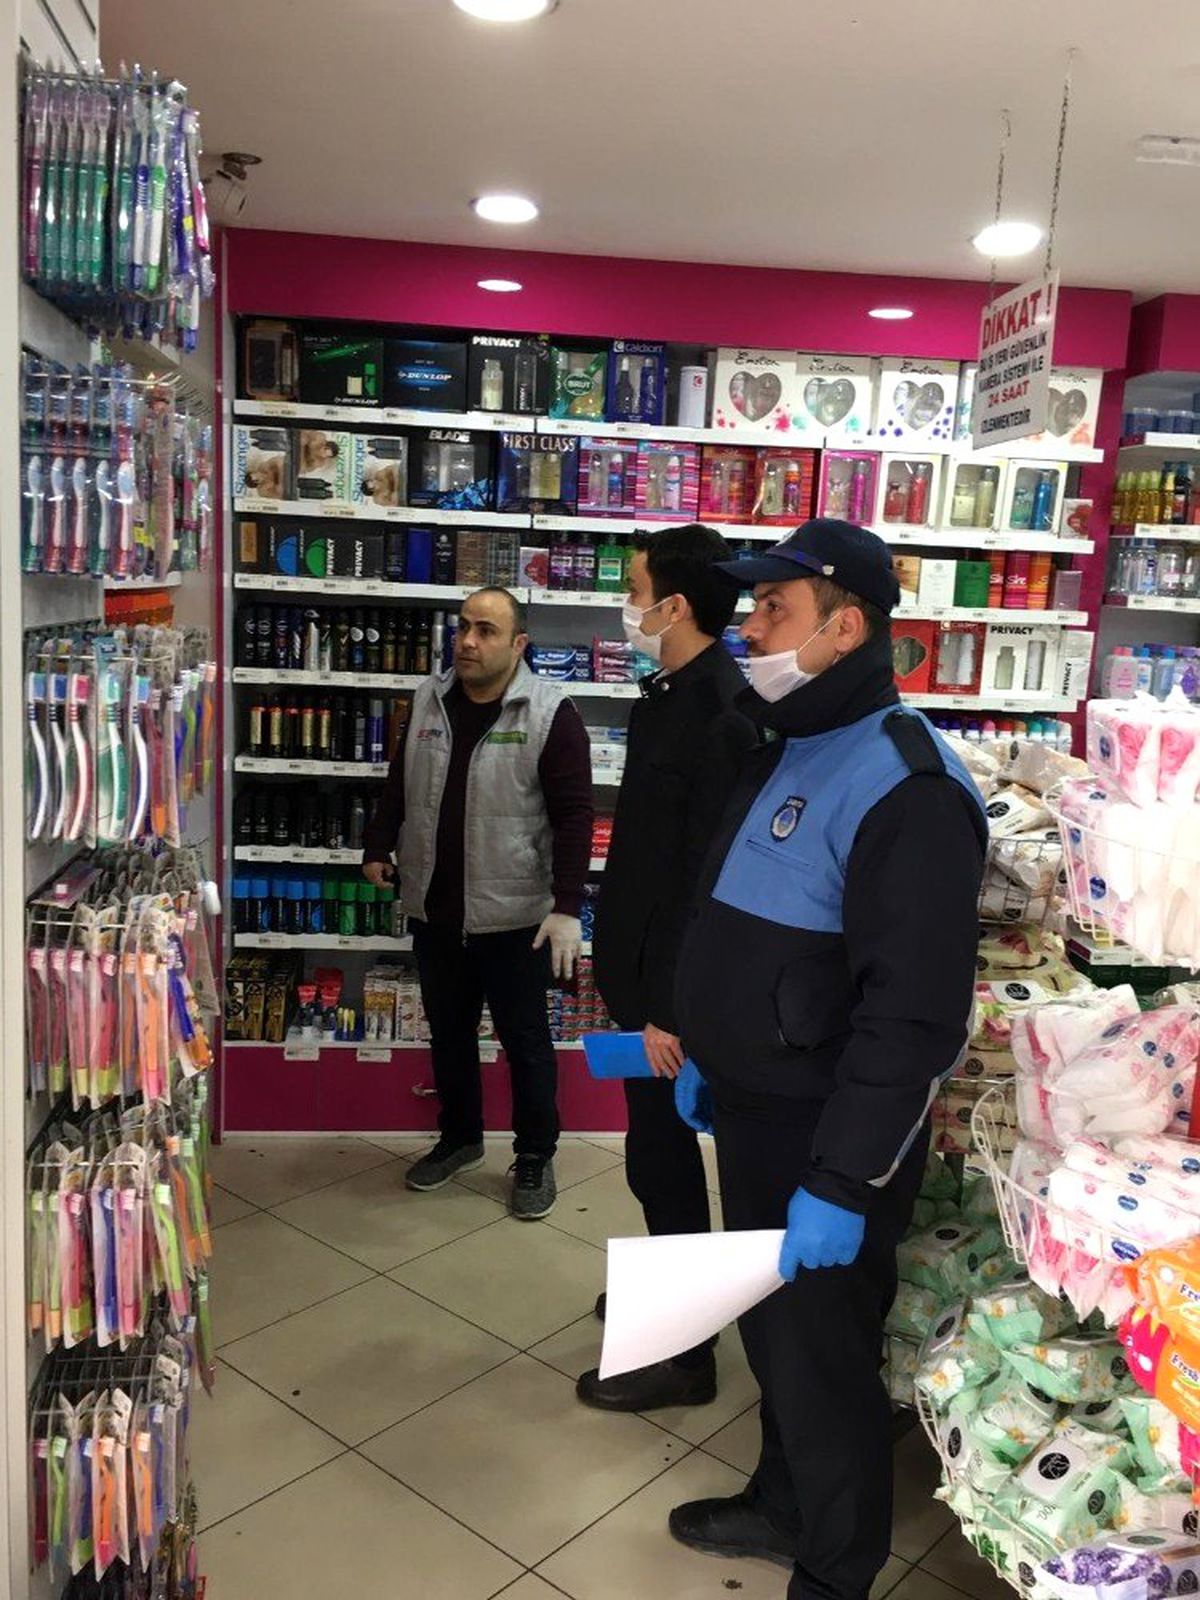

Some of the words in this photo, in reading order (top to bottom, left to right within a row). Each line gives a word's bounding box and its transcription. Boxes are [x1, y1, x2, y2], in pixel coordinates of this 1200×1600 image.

[982, 289, 1042, 349] DİKKAT
[472, 336, 522, 348] PRIVACY
[735, 351, 780, 367] Emotion
[900, 360, 943, 375] Emotion
[407, 372, 452, 381] DUNLOP
[1002, 380, 1030, 403] SAAT
[428, 430, 471, 443] BLADE
[503, 434, 536, 450] FIRST
[540, 436, 577, 451] CLASS
[235, 429, 250, 496] Slazenger
[334, 434, 349, 500] Slazenger
[352, 438, 366, 503] Slazenger
[326, 538, 335, 575] PRIVACY
[353, 540, 364, 577] PRIVACY
[990, 625, 1034, 635] PRIVACY
[1061, 662, 1073, 696] PRIVACY
